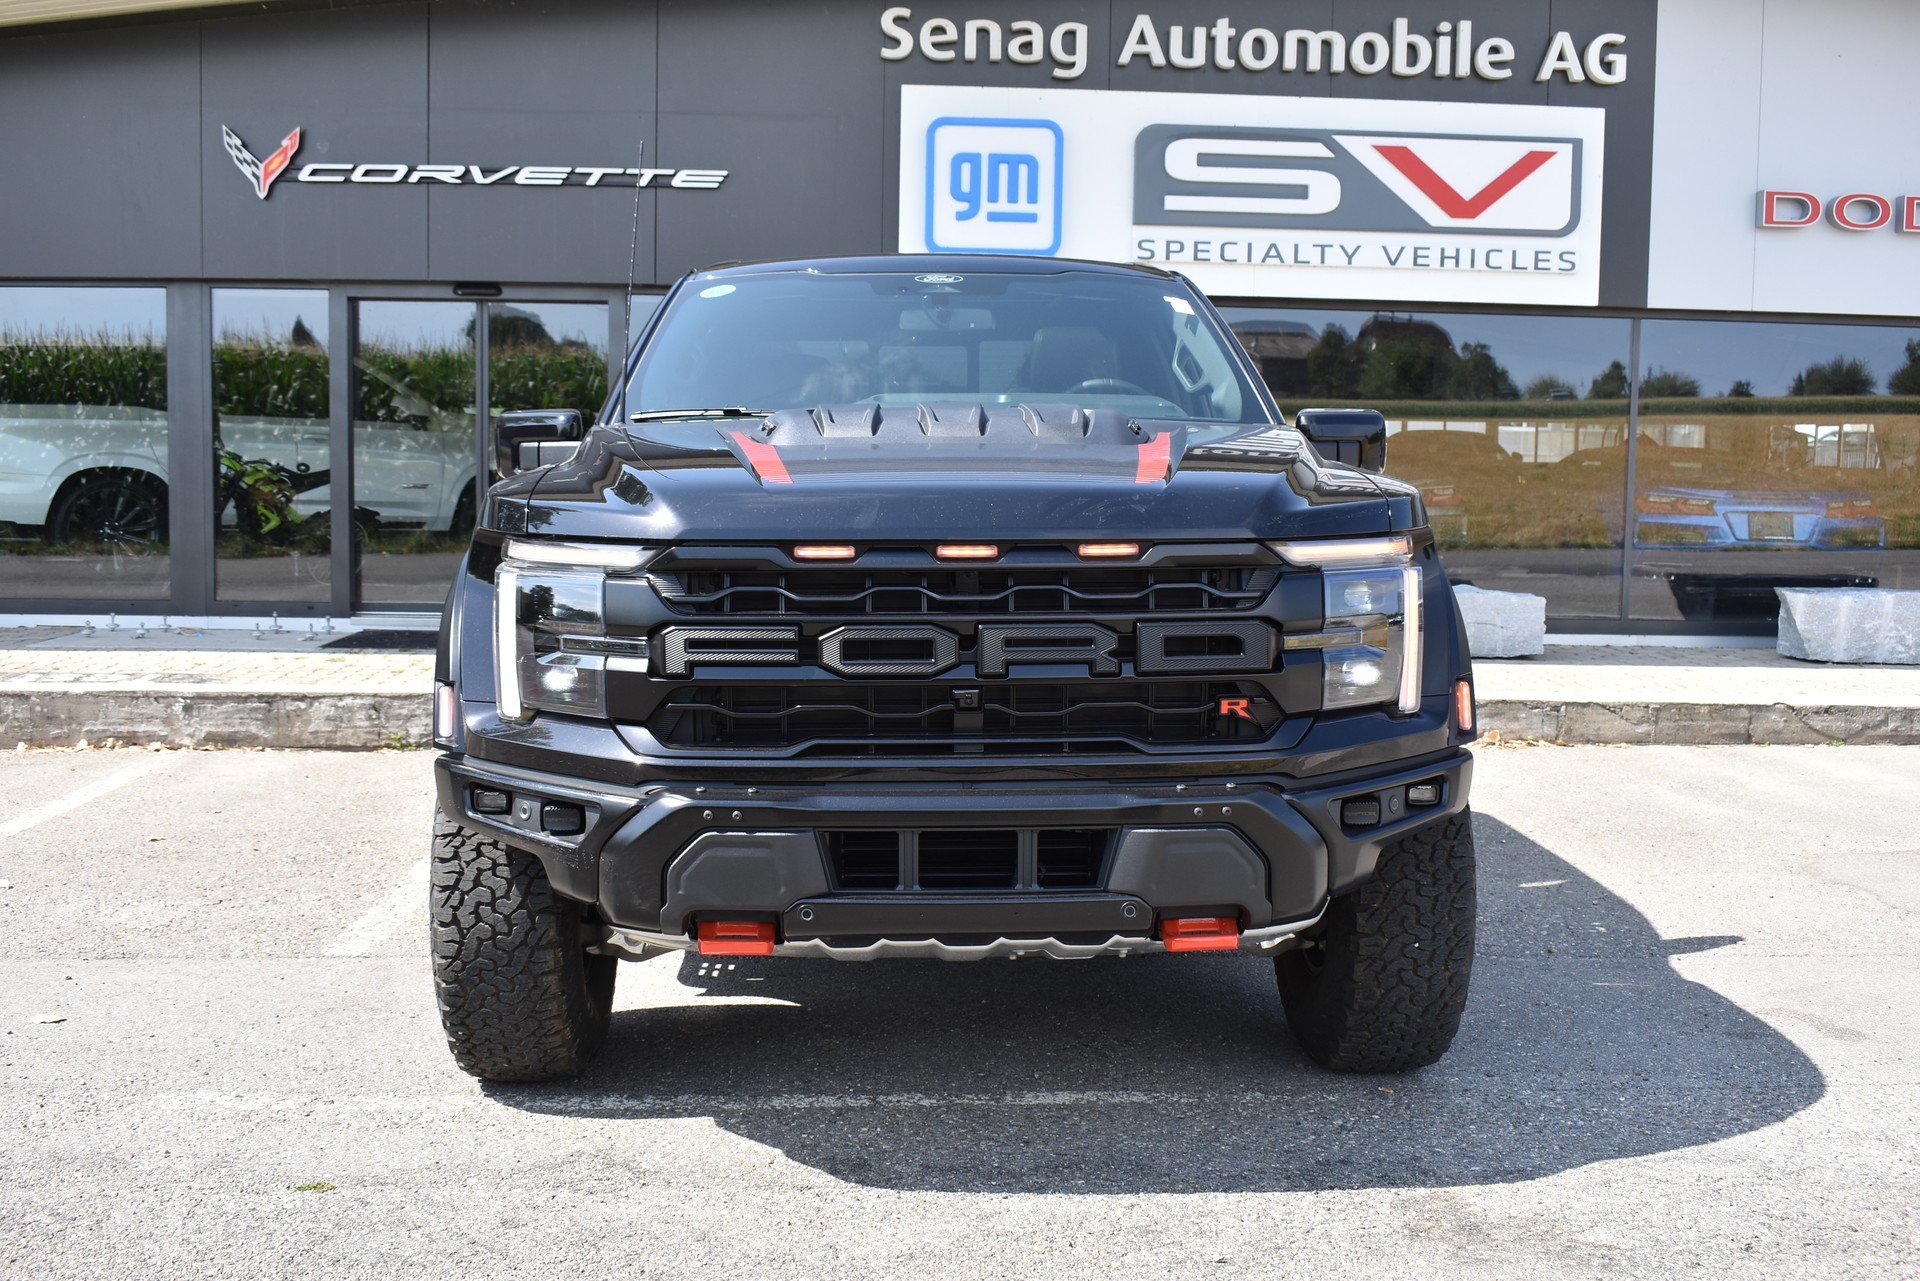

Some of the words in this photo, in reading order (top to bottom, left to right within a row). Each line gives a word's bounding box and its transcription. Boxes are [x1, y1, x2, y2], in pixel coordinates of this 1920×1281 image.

[880, 7, 1089, 79] Senag
[1117, 14, 1516, 80] Automobile
[1536, 32, 1628, 84] AG
[297, 163, 729, 189] CORVETTE
[950, 151, 1039, 223] gm
[1163, 137, 1559, 219] SV
[1756, 190, 1920, 233] DO
[1137, 238, 1363, 266] SPECIALTY
[1381, 245, 1577, 272] VEHICLES
[661, 620, 1275, 677] FORD
[1219, 699, 1252, 719] R
